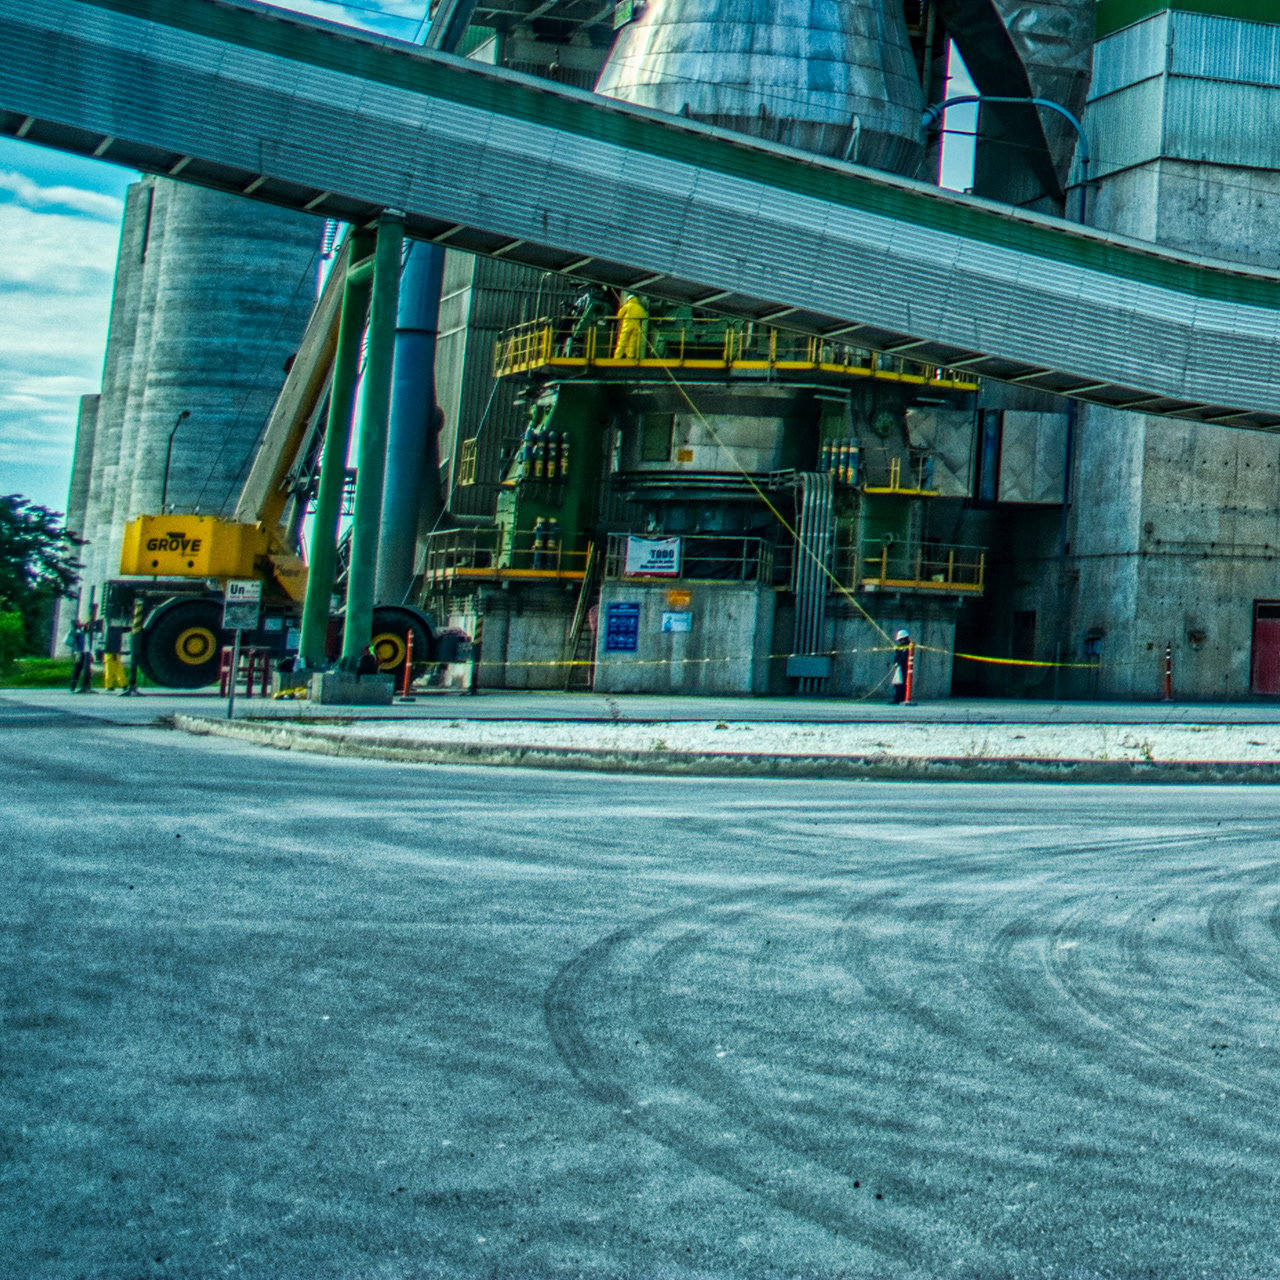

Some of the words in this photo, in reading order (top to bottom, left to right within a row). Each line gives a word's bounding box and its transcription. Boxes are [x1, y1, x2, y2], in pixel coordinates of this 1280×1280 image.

[147, 538, 202, 552] GROVE
[651, 549, 675, 559] TODO
[230, 584, 245, 595] Un
